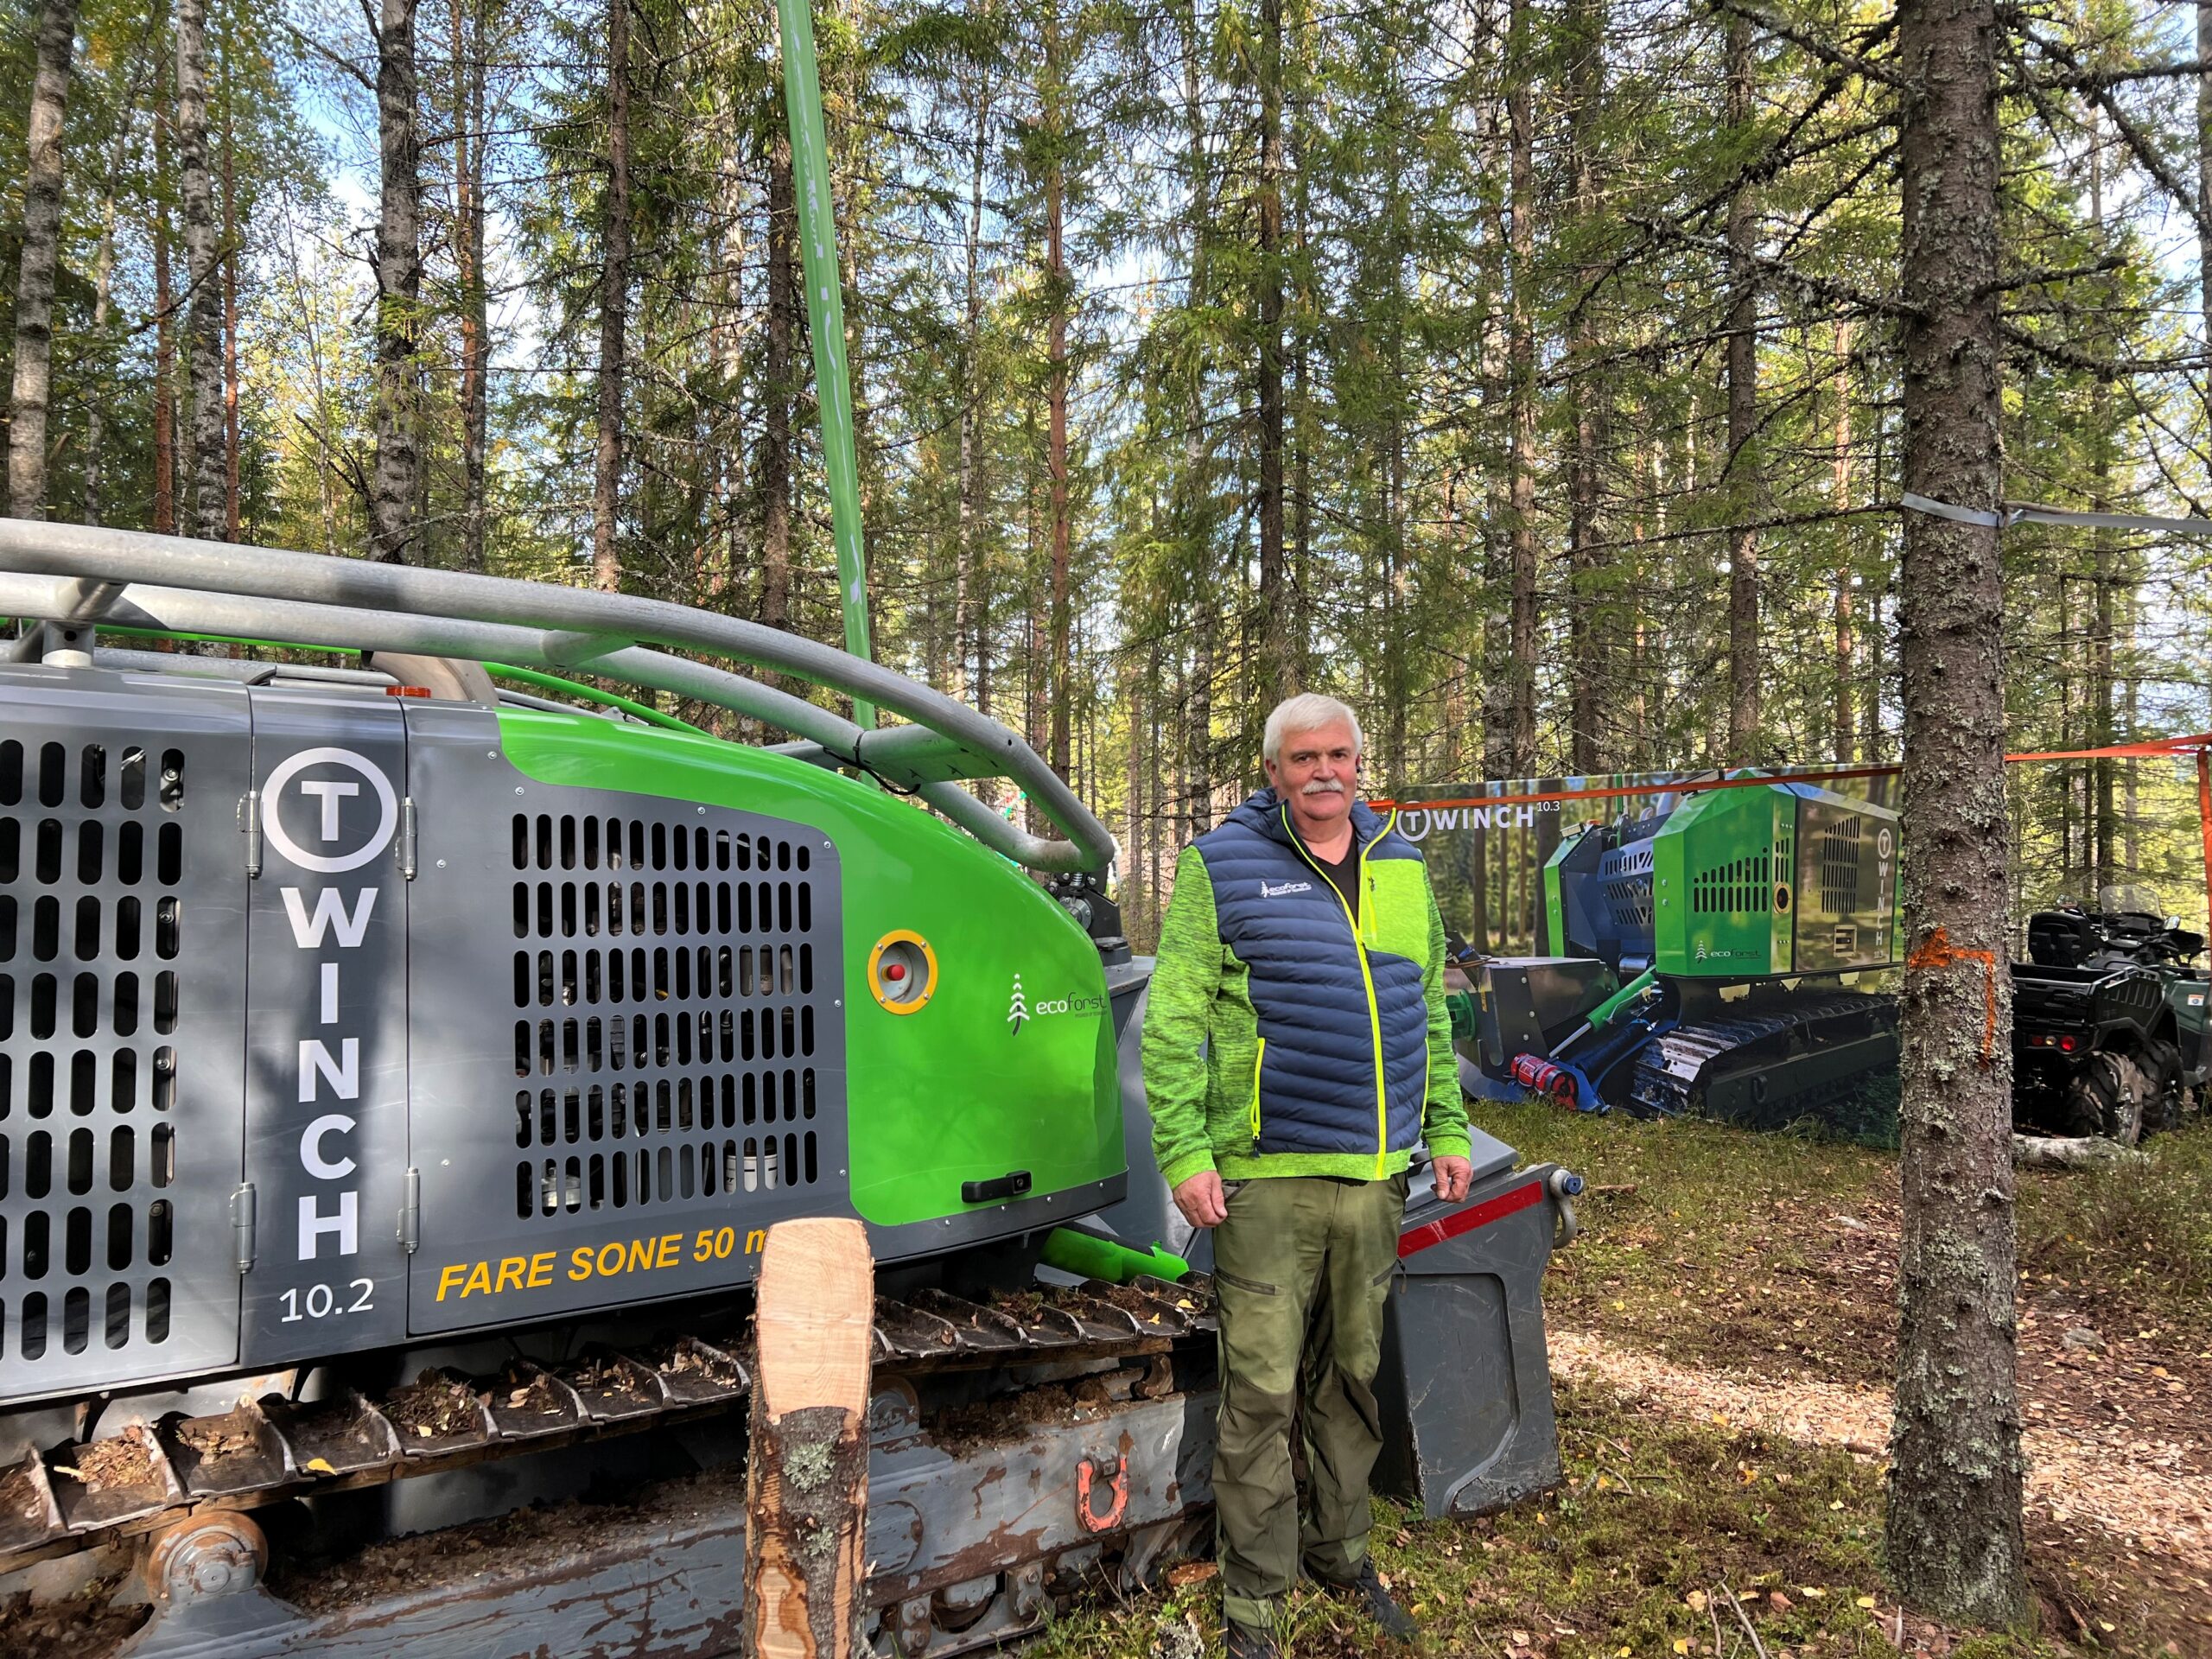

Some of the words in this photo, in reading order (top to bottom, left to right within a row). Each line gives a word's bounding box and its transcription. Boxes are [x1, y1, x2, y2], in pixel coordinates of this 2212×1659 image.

[1537, 800, 1560, 811] 10.3
[1036, 992, 1107, 1014] ecoforst
[435, 1251, 557, 1302] FARE
[567, 1232, 683, 1281] SONE
[692, 1226, 734, 1262] 50
[279, 1277, 375, 1323] 10.2
